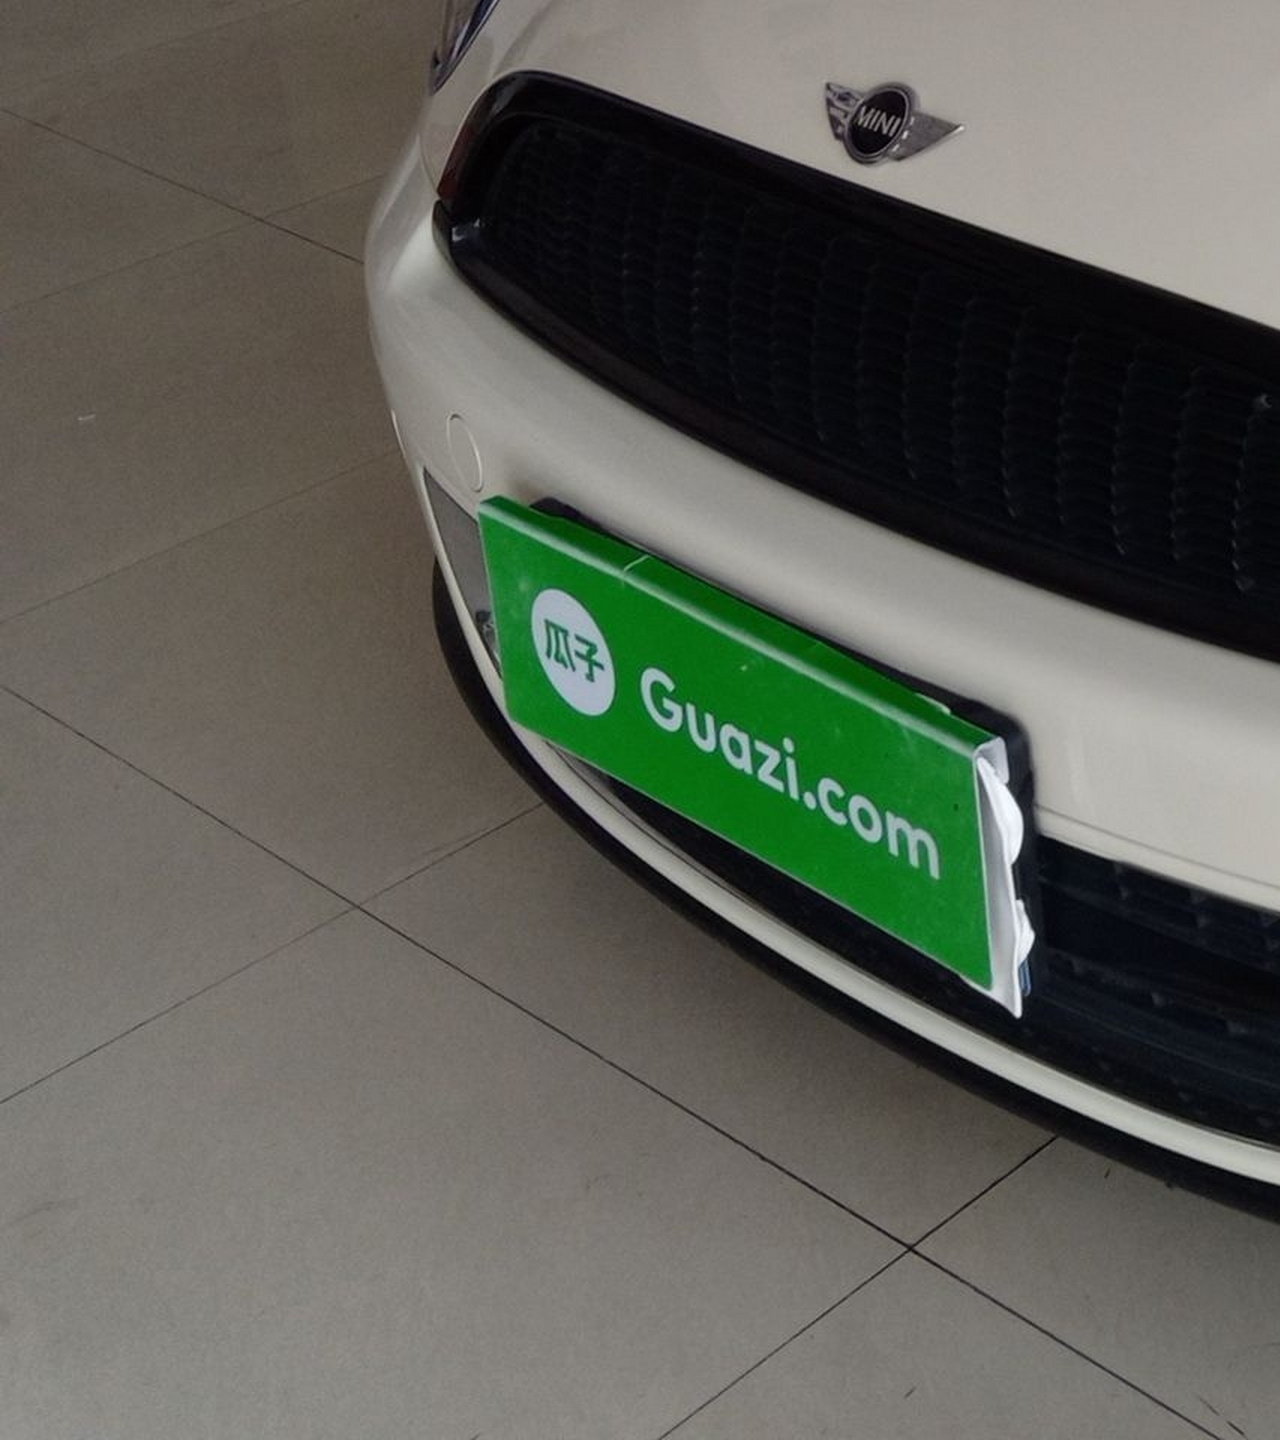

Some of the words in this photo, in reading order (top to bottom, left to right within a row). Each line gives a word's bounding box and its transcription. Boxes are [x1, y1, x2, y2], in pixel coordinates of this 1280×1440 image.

[855, 106, 901, 137] MINI
[544, 618, 605, 683] 瓜子
[640, 666, 941, 880] Guazi.com
